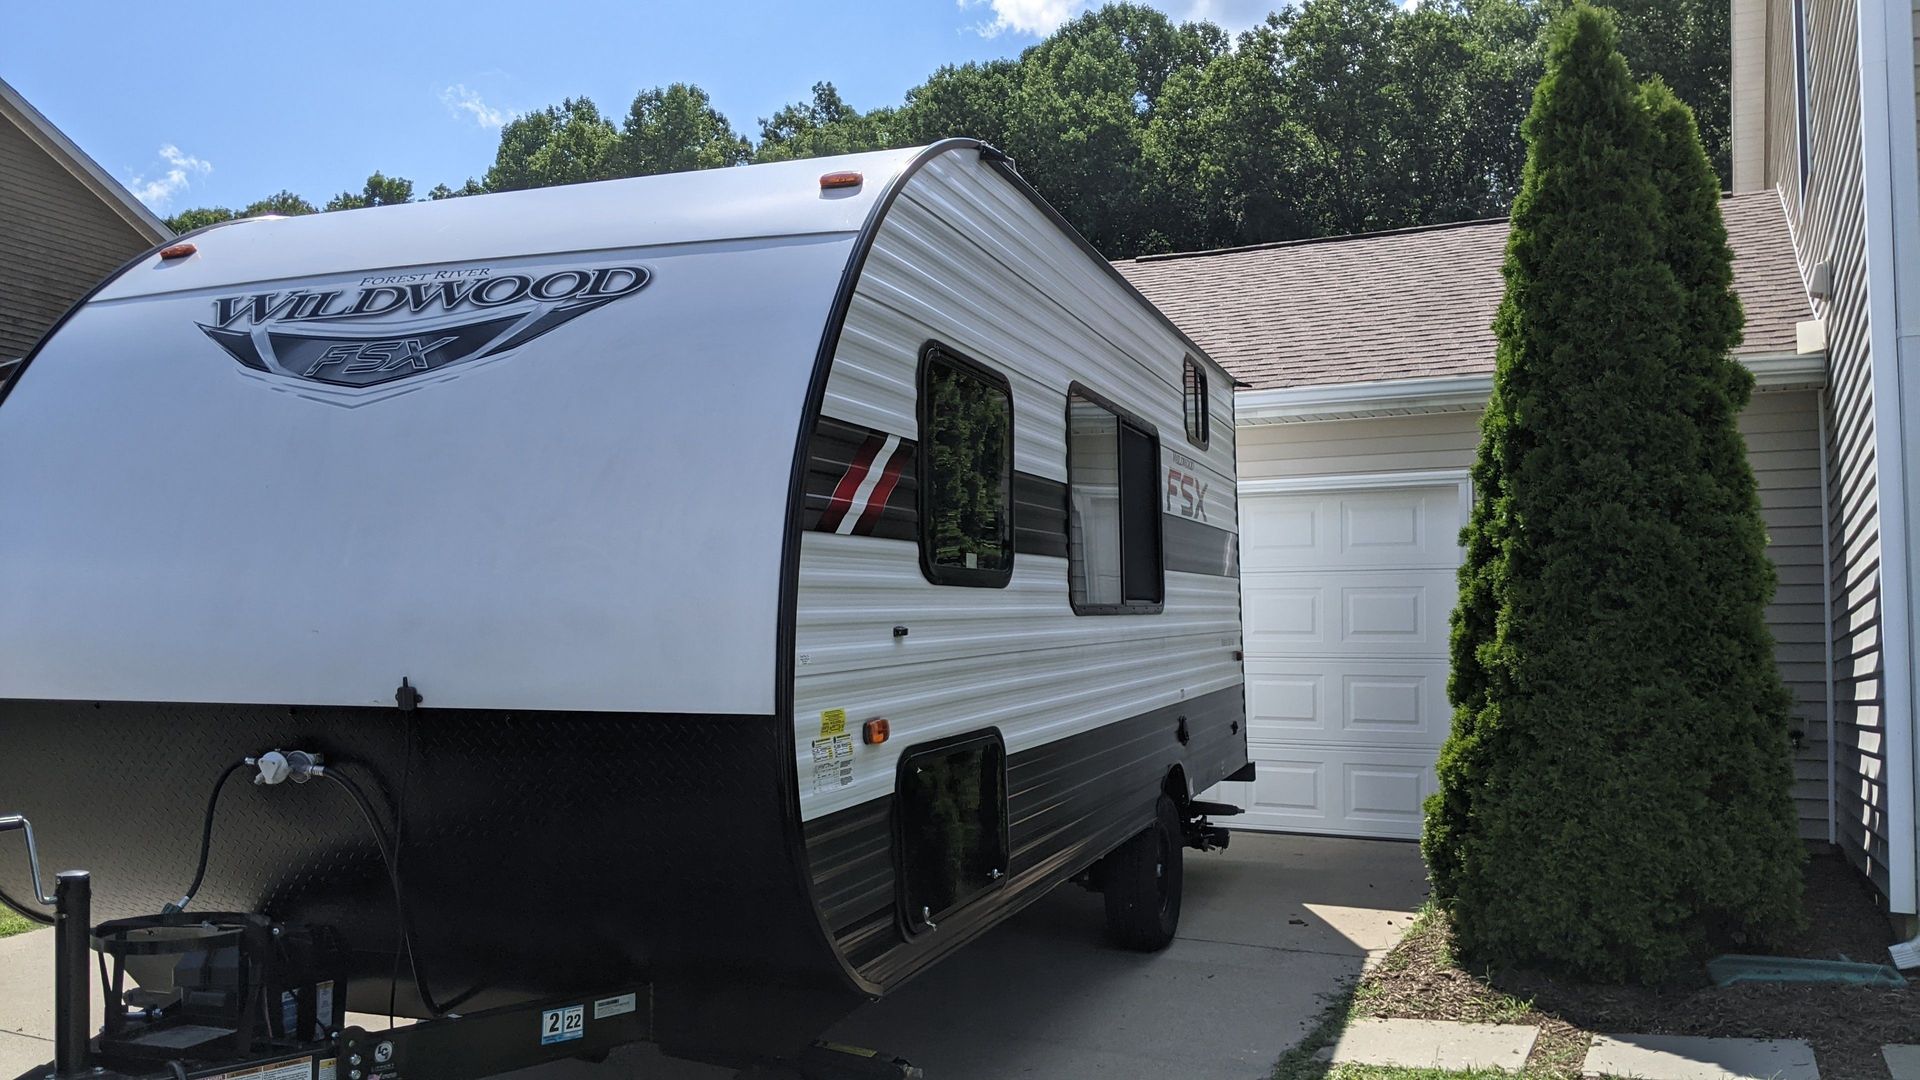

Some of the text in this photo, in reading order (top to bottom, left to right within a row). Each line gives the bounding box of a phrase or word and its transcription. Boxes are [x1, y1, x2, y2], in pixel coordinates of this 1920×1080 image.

[213, 265, 652, 328] WILDWOOD
[360, 267, 490, 286] FOREST RIVER
[303, 336, 459, 377] FSX
[1166, 468, 1208, 522] FSX
[549, 1013, 581, 1033] 2 22
